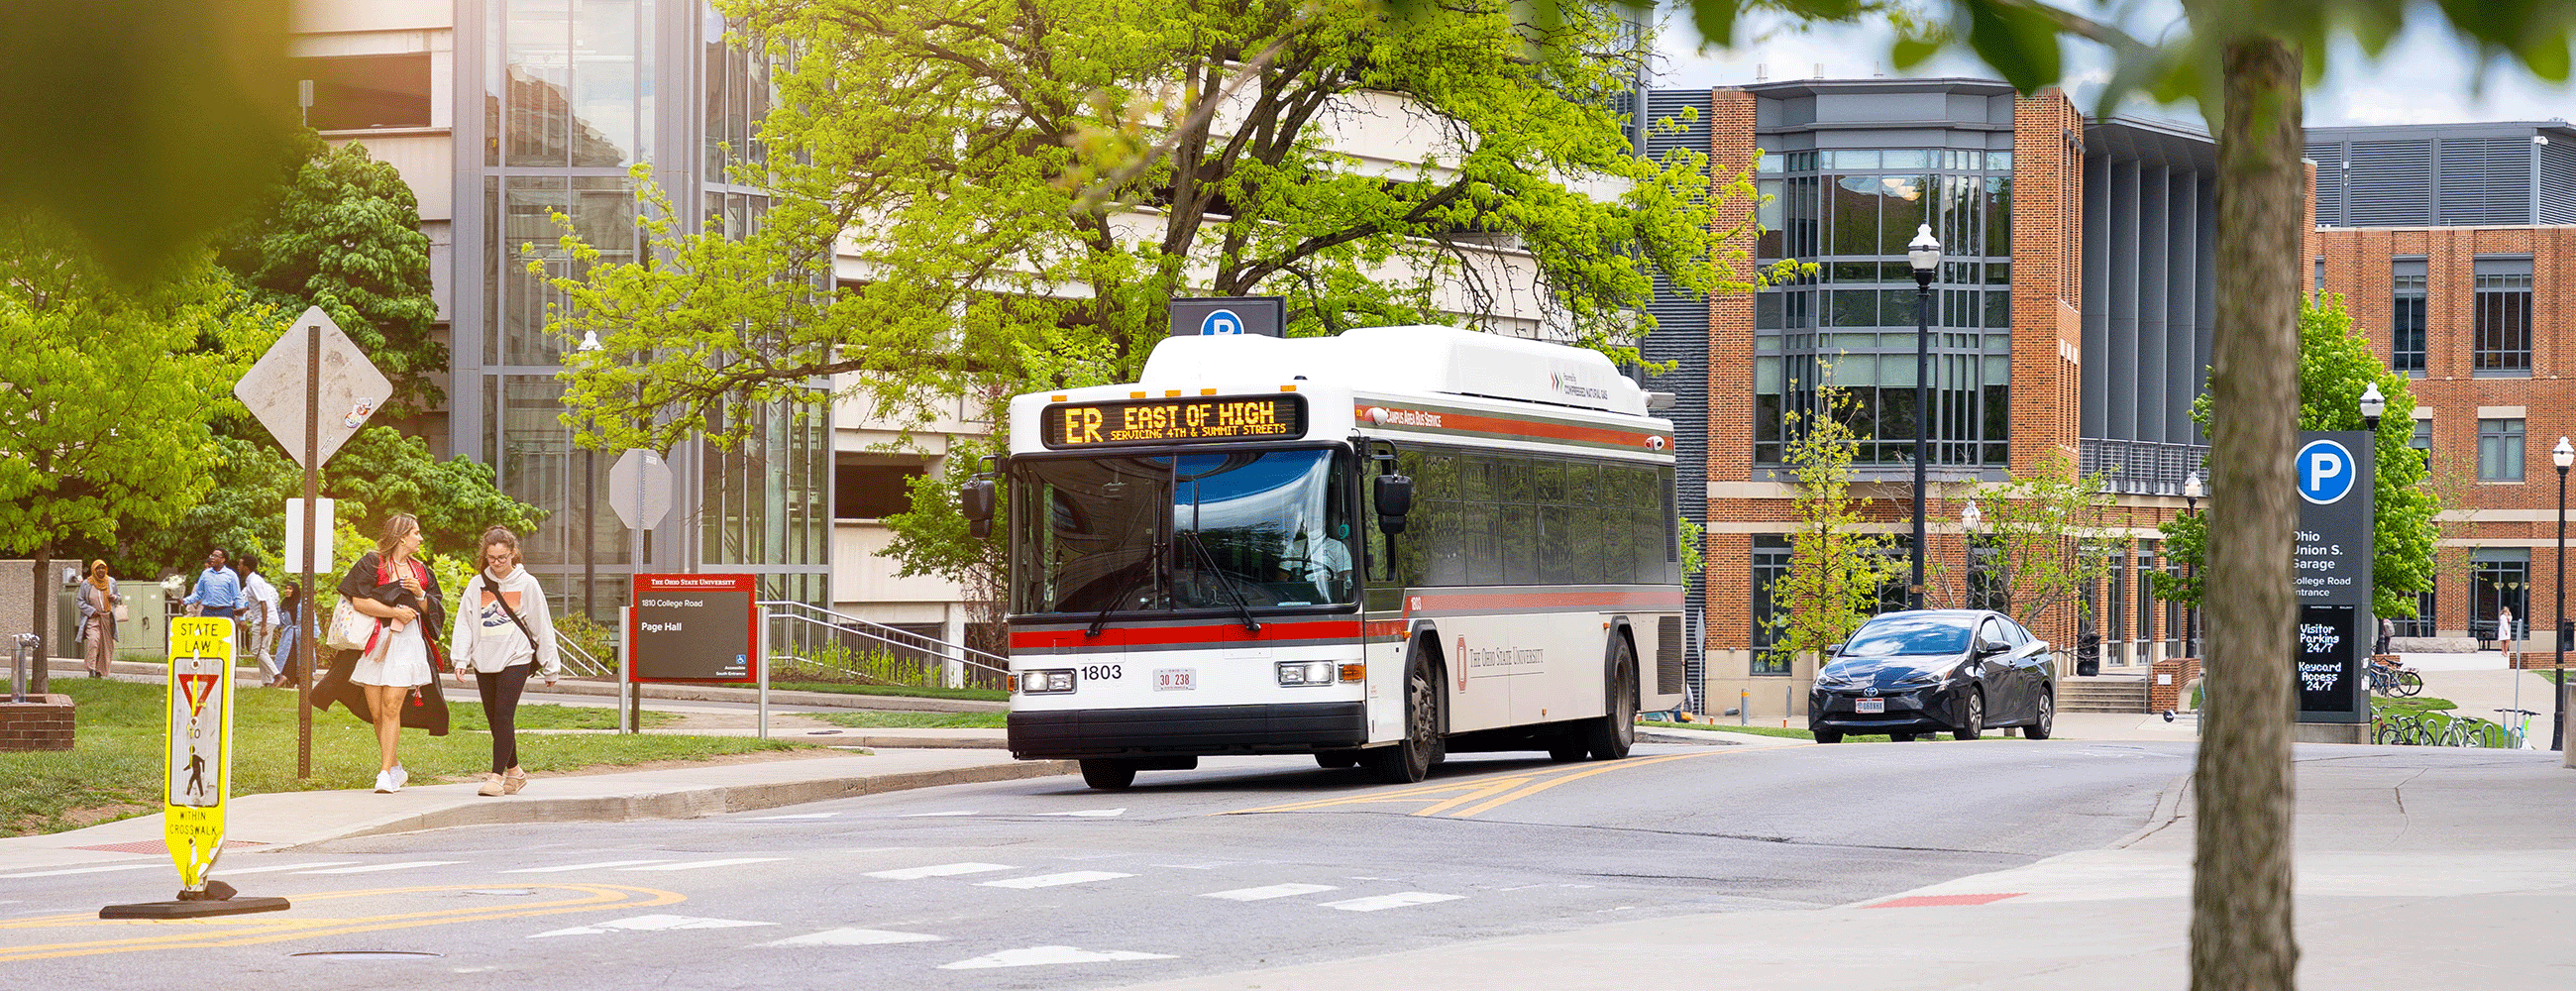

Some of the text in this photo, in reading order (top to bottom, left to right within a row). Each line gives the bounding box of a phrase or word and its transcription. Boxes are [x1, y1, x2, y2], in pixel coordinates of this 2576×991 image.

[1065, 401, 1274, 444] ER EAST OF HIGH
[1110, 423, 1287, 441] SERVICING 4TH & SUMMIT STREETS
[2310, 453, 2342, 492] P
[2331, 544, 2343, 555] S.
[2327, 577, 2352, 586] Road
[656, 600, 683, 608] College
[180, 623, 219, 636] STATE
[641, 622, 682, 633] Page Hall
[2300, 623, 2335, 634] Visitor
[2300, 633, 2339, 644] Parking
[185, 640, 211, 653] LAW
[2307, 643, 2333, 653] 24/7
[2298, 661, 2342, 672] Keycard
[1081, 665, 1122, 680] 1803
[2302, 671, 2338, 682] Access
[1160, 674, 1190, 686] 30 238
[2306, 681, 2333, 691] 24/7
[180, 811, 206, 822] WITHIN
[169, 824, 217, 835] CROSSWALK
